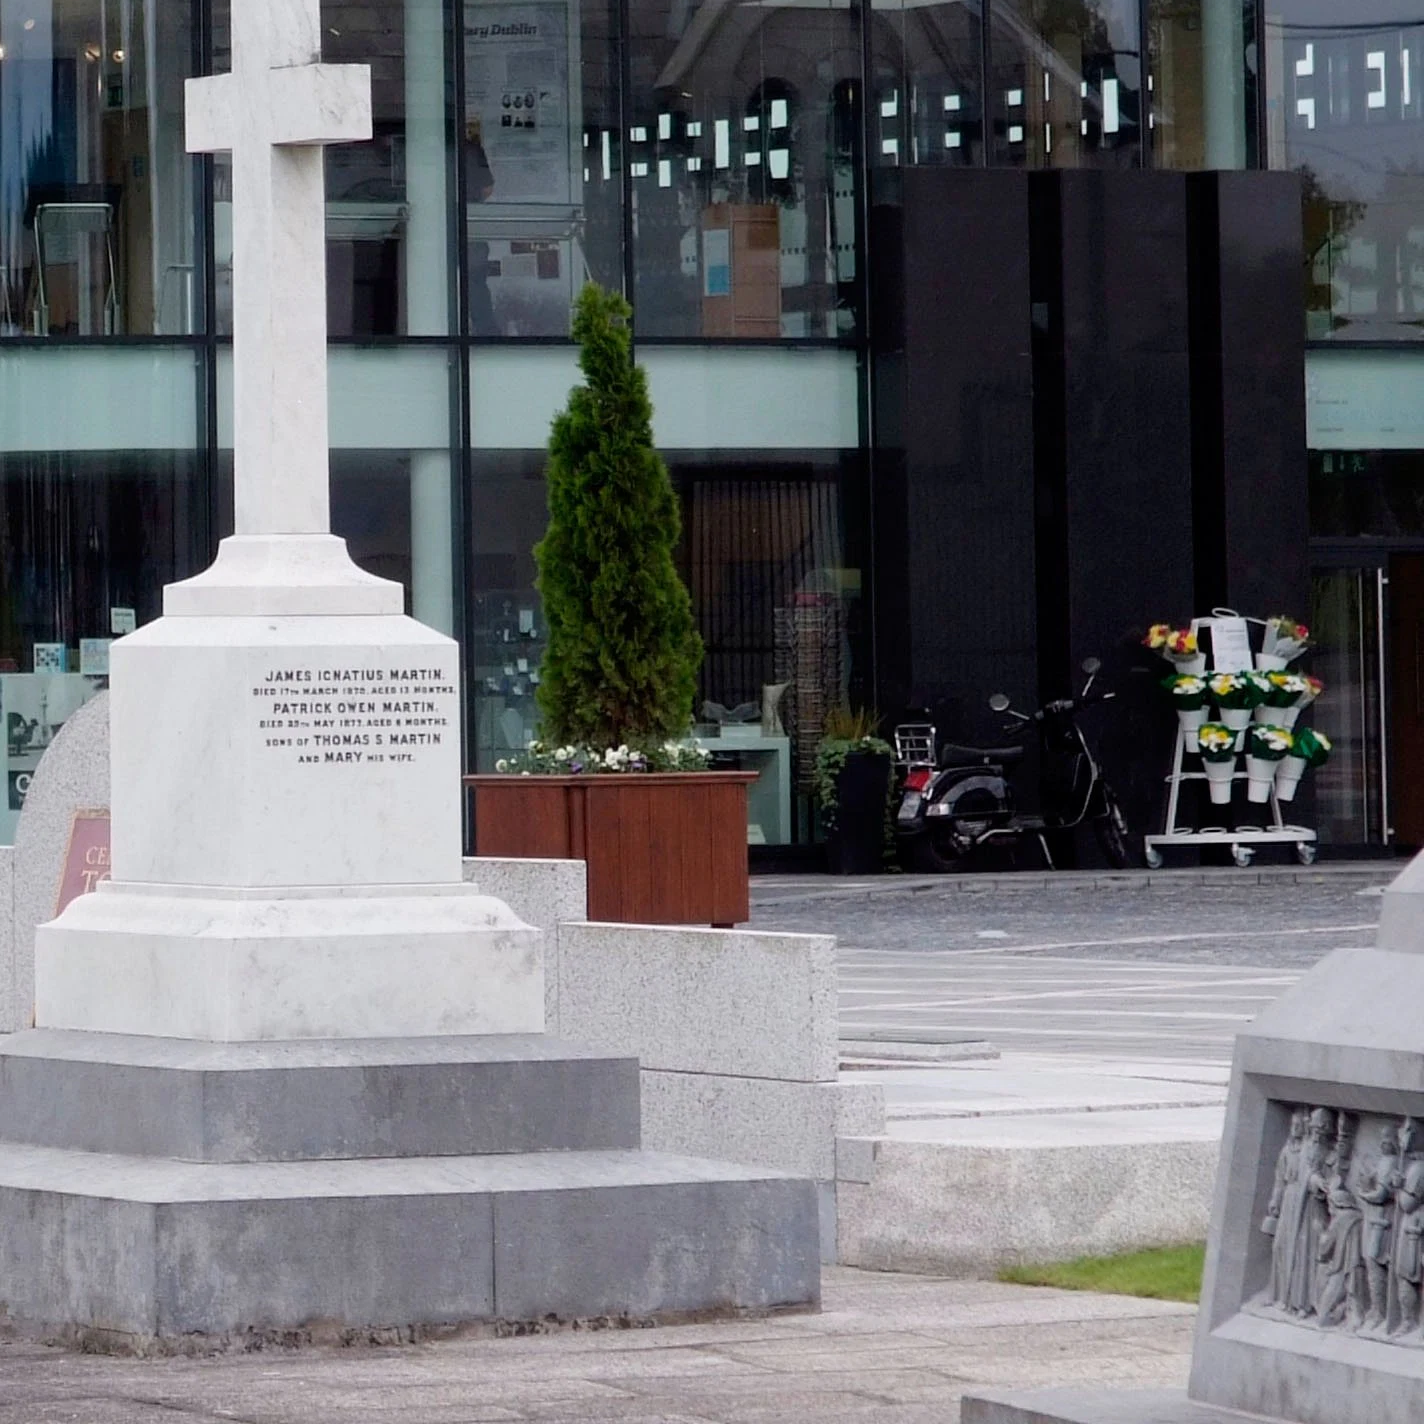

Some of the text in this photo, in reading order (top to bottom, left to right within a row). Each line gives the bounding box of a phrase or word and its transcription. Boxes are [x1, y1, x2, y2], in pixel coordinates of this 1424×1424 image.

[490, 22, 537, 36] Dublin
[265, 670, 311, 682] JAMES
[318, 669, 384, 681] IGNATIUS
[253, 688, 277, 696] DIED
[303, 687, 338, 695] MARCH
[371, 686, 397, 694] AGED
[273, 702, 331, 714] PATRICK
[337, 702, 375, 713] OWEN
[259, 720, 283, 728] DIED
[314, 719, 334, 727] MAY
[266, 733, 441, 747] SONS OF THOMAS S MARTIN
[298, 755, 319, 763] AND
[324, 752, 362, 763] MARY
[367, 754, 384, 762] HIS
